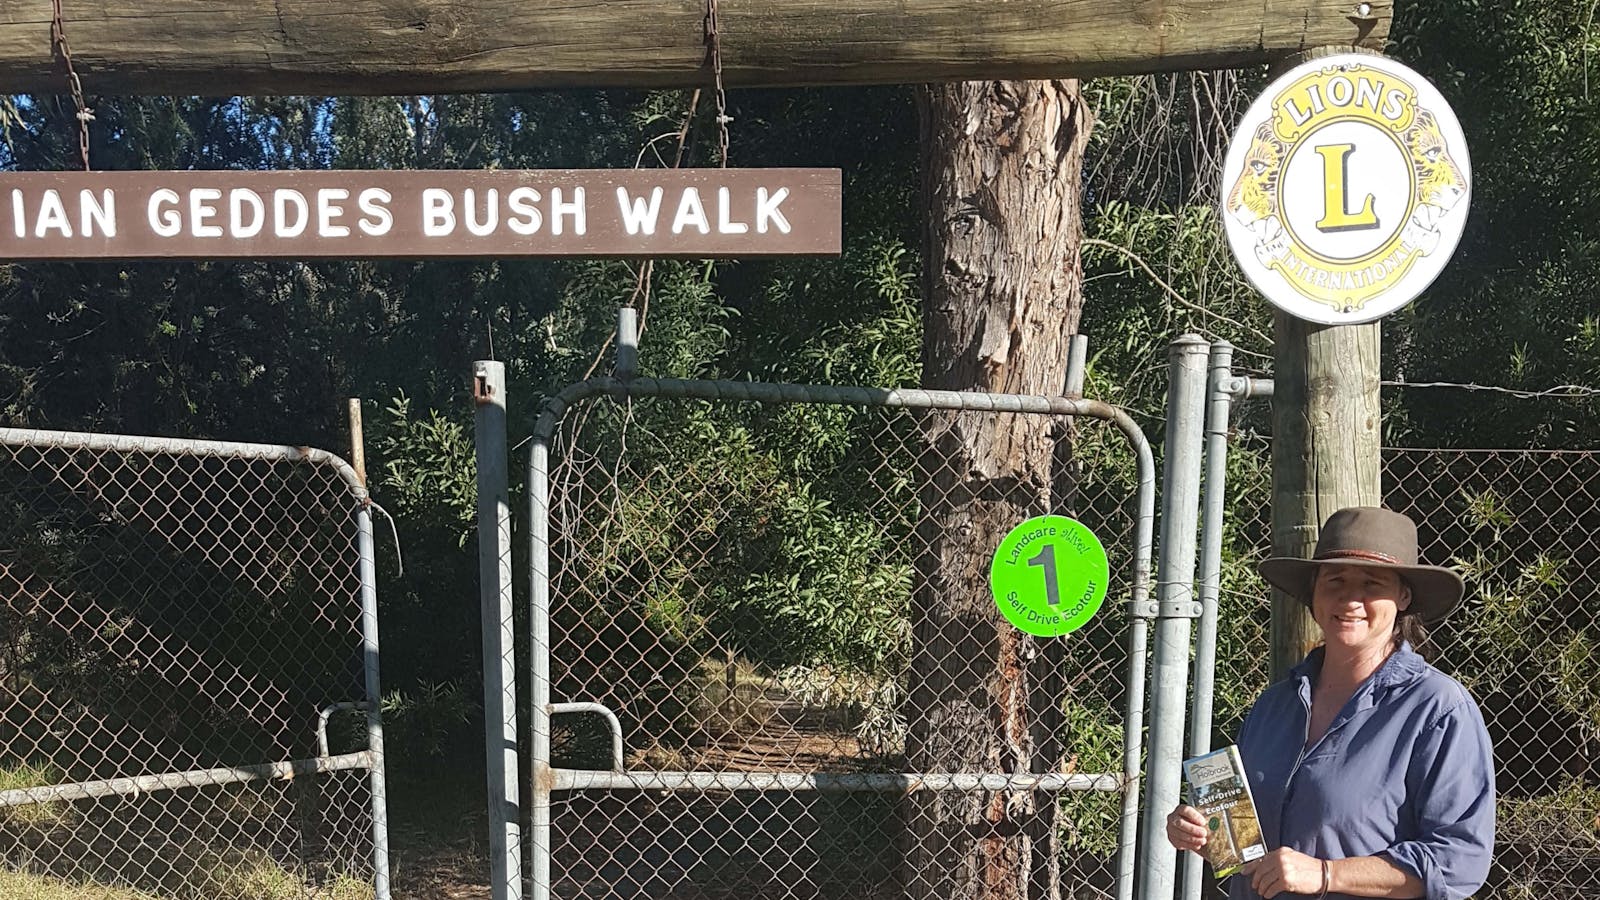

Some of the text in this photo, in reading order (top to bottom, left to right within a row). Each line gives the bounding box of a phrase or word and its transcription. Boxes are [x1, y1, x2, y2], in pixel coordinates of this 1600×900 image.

[1283, 77, 1407, 127] LIONS
[12, 186, 792, 238] IAN GEDDES BUSH WALK
[1315, 143, 1381, 233] L
[1280, 240, 1419, 290] INTERNATIONAL
[1005, 527, 1091, 565] Landcare alive!
[1027, 544, 1060, 606] 1
[1006, 580, 1097, 625] Self Drive Ecotour
